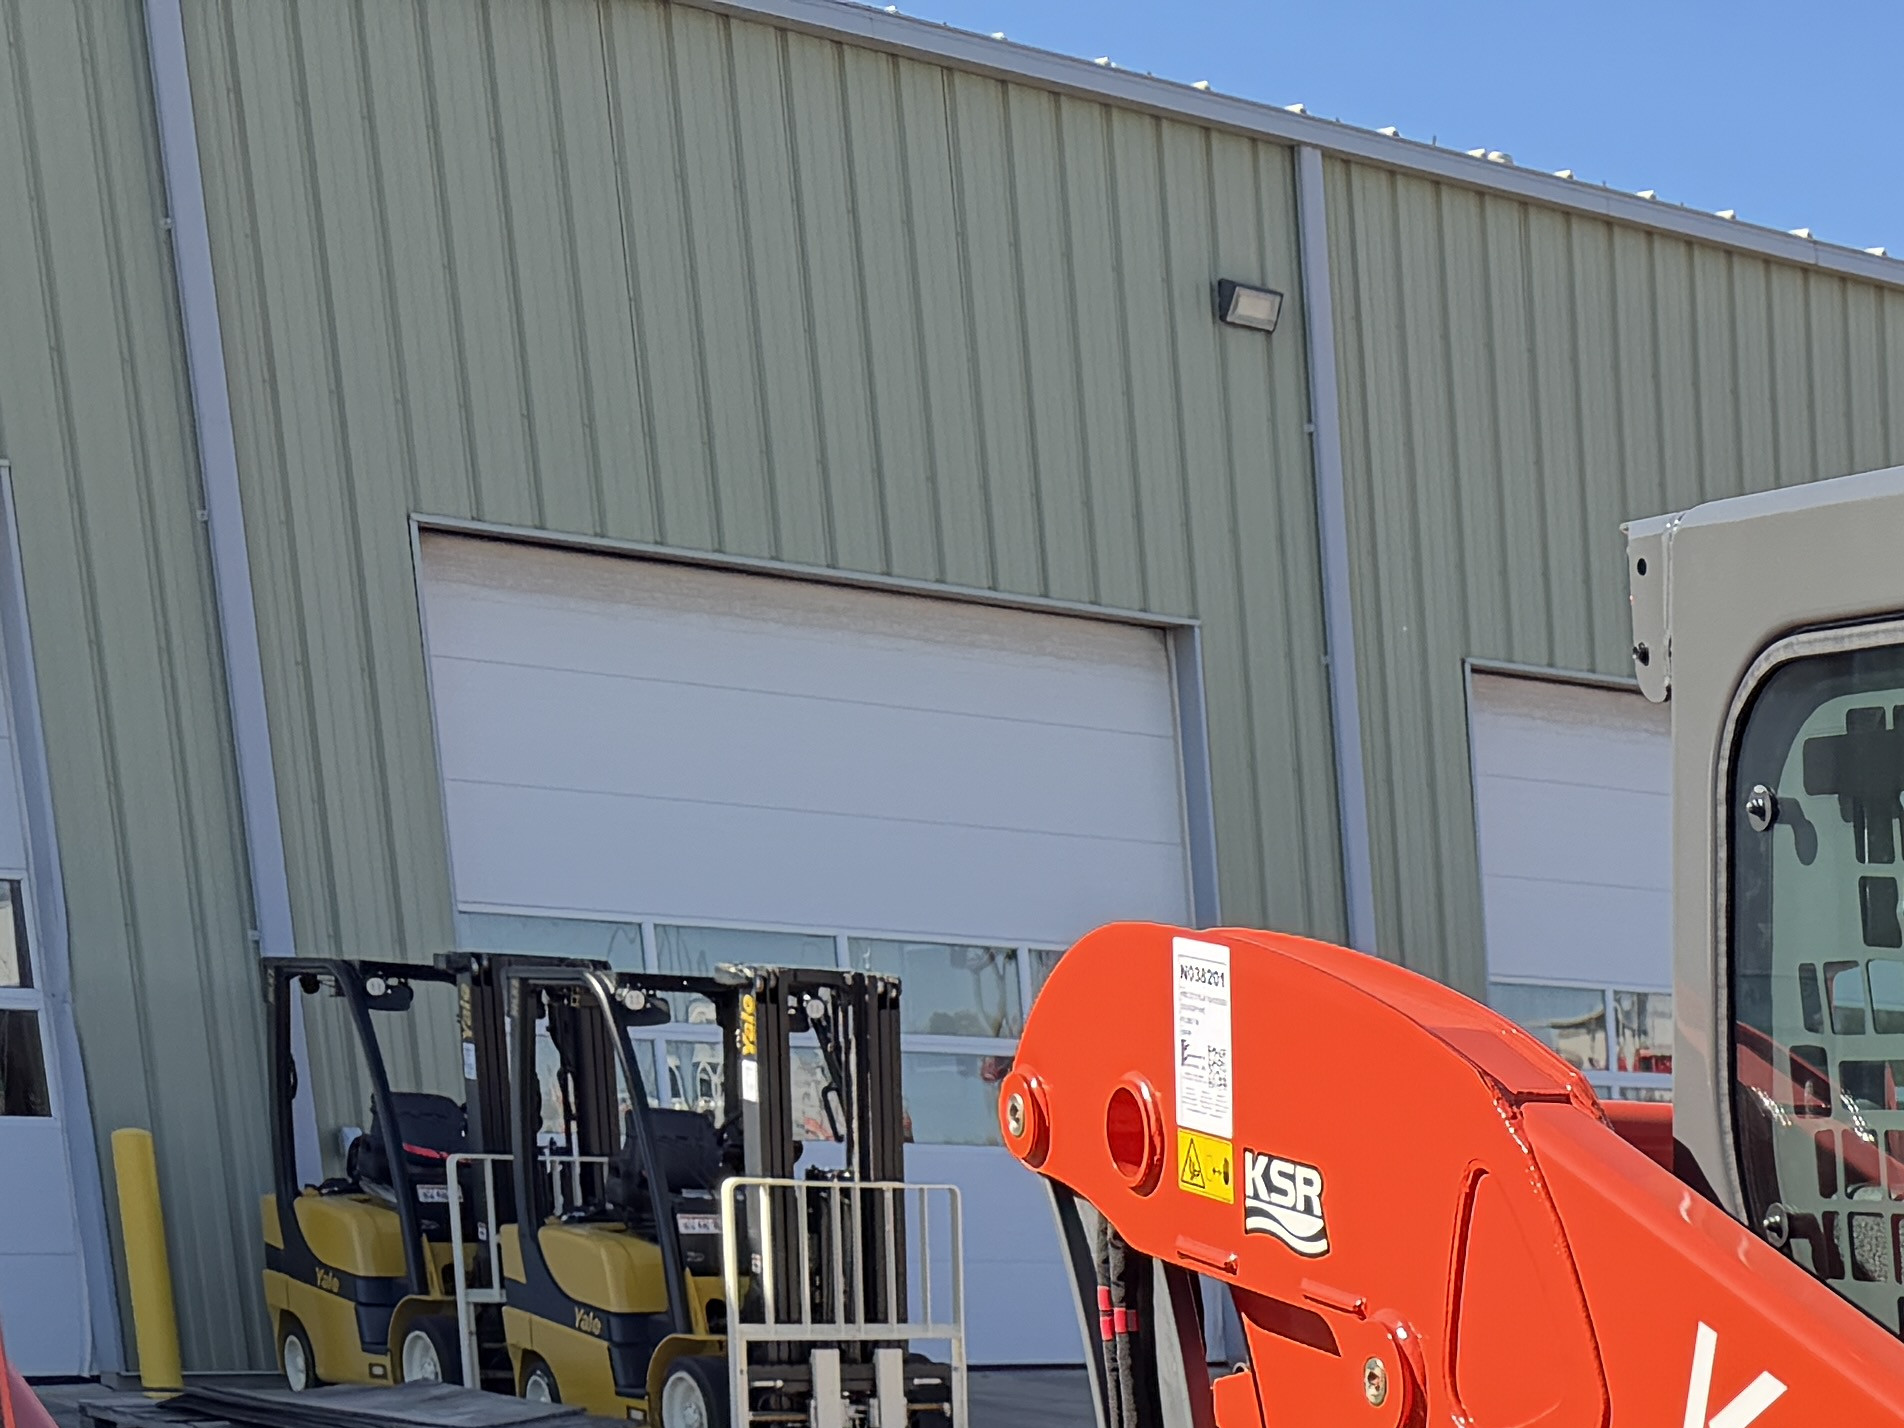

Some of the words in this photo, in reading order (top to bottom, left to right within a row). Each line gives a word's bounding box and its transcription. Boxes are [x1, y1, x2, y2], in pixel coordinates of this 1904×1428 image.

[1180, 964, 1225, 987] N038201
[741, 994, 757, 1055] Yale
[1245, 1151, 1323, 1216] KSR
[574, 1306, 601, 1336] Yale
